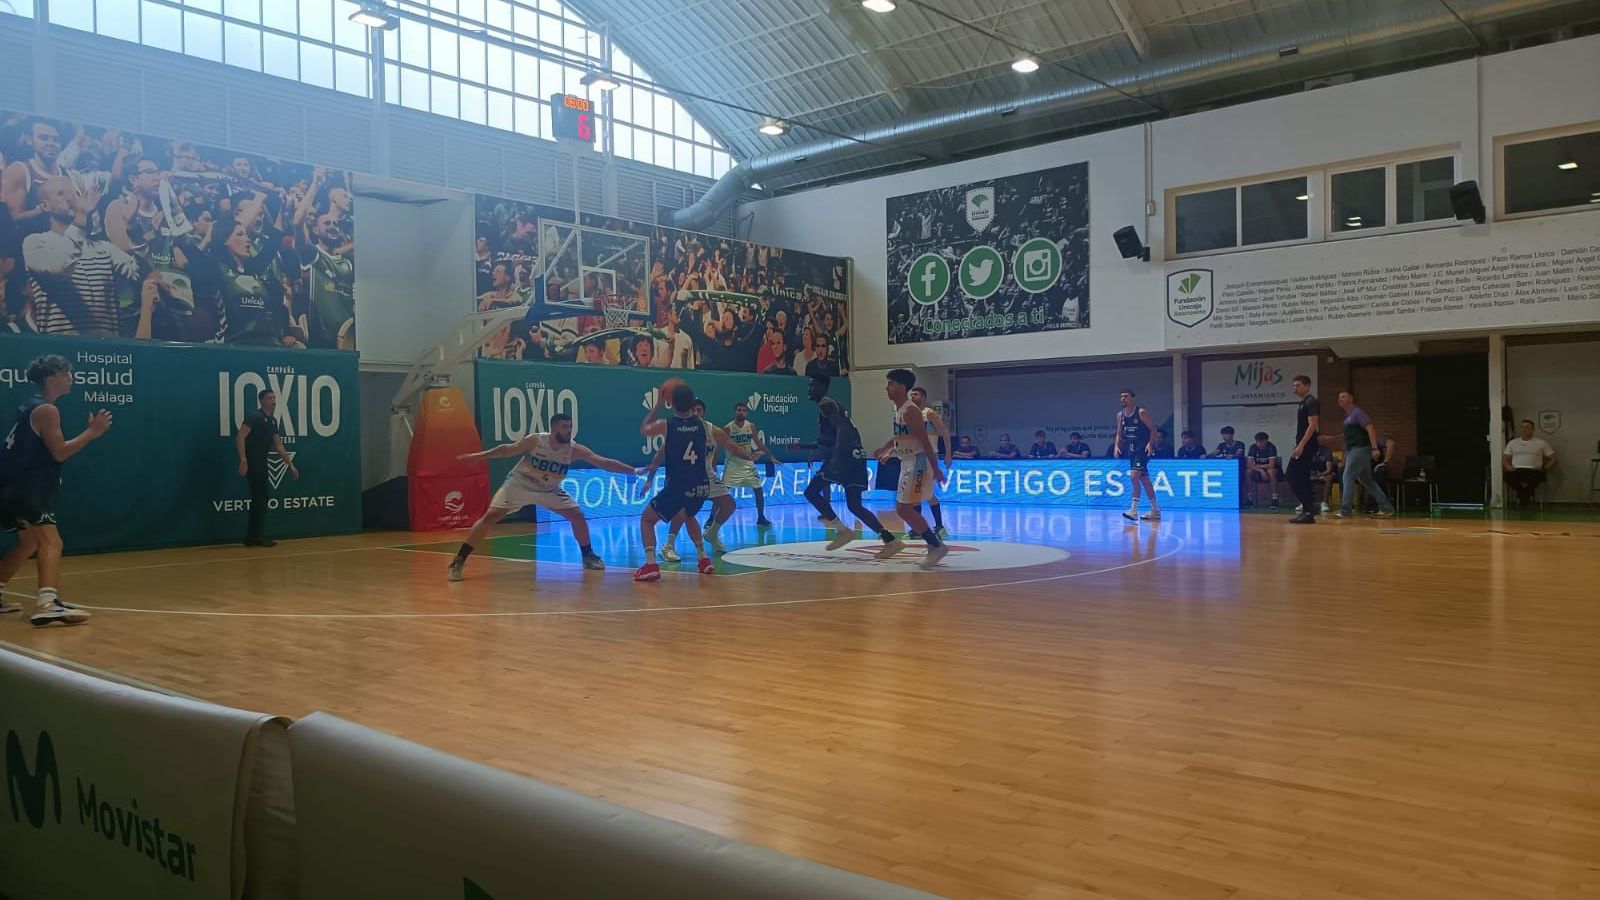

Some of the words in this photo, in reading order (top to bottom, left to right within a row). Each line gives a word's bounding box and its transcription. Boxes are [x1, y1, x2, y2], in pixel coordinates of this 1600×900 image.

[578, 114, 590, 140] 6
[923, 310, 1014, 333] Conectados
[1018, 311, 1028, 326] a
[1031, 305, 1045, 324] ti
[77, 351, 133, 365] Hospital
[267, 365, 295, 374] CAMPAÑA
[1235, 361, 1282, 390] Mijas
[0, 368, 133, 389] qusalud
[84, 390, 133, 405] Málaga
[763, 393, 798, 404] Fundación
[1231, 391, 1286, 400] AYUNTAMIENTO
[763, 403, 789, 415] Unicaja
[769, 435, 801, 446] Movistar
[682, 441, 699, 465] 4
[939, 469, 1071, 496] VERTIGO
[1084, 470, 1223, 499] ESATE
[213, 498, 279, 512] VERTO
[284, 495, 335, 509] ESTATE
[76, 776, 197, 883] Movistar
